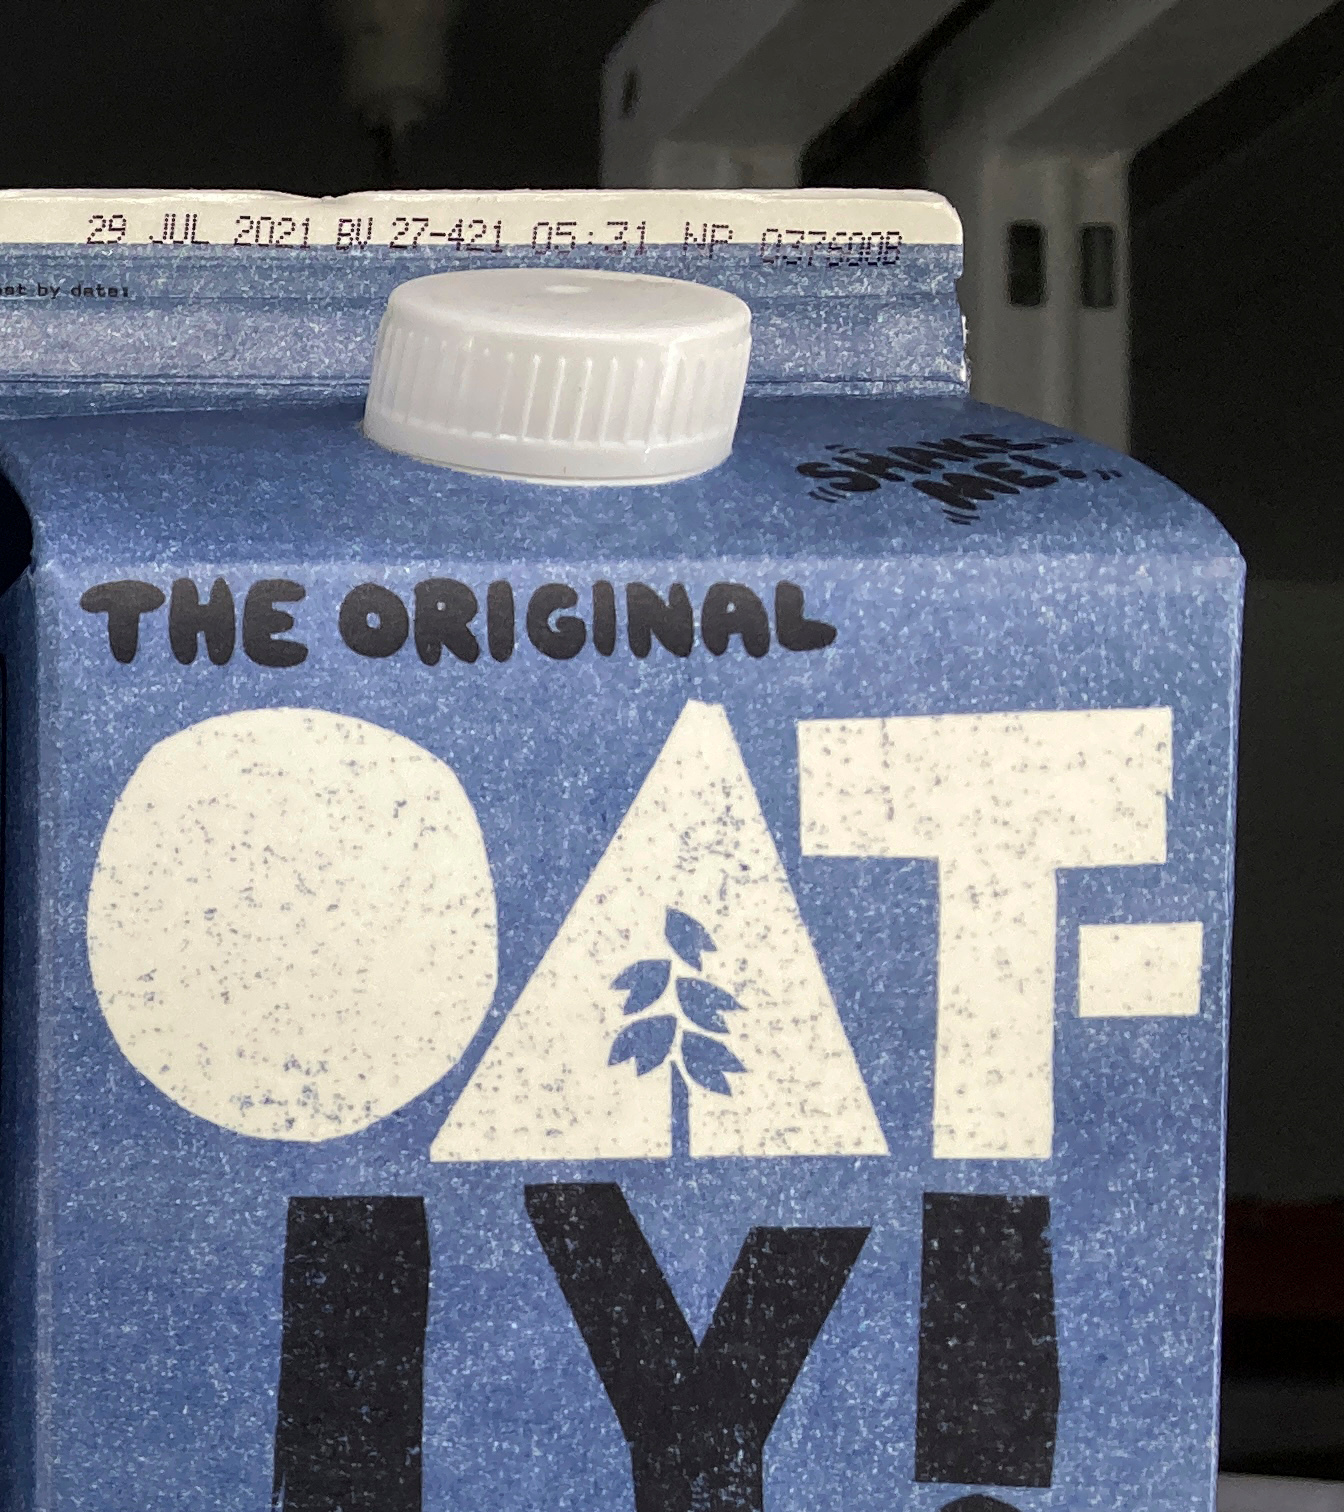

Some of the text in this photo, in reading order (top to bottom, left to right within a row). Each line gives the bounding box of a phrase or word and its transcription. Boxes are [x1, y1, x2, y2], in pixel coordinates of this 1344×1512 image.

[87, 214, 127, 244] 29
[149, 213, 209, 244] JUL
[234, 215, 310, 249] 2021
[336, 217, 373, 251] BV
[390, 217, 502, 253] 27-421
[532, 221, 646, 255] 05:31
[37, 283, 60, 299] by
[79, 577, 837, 668] THE ORIGINAL
[87, 699, 1202, 1163] OAT-
